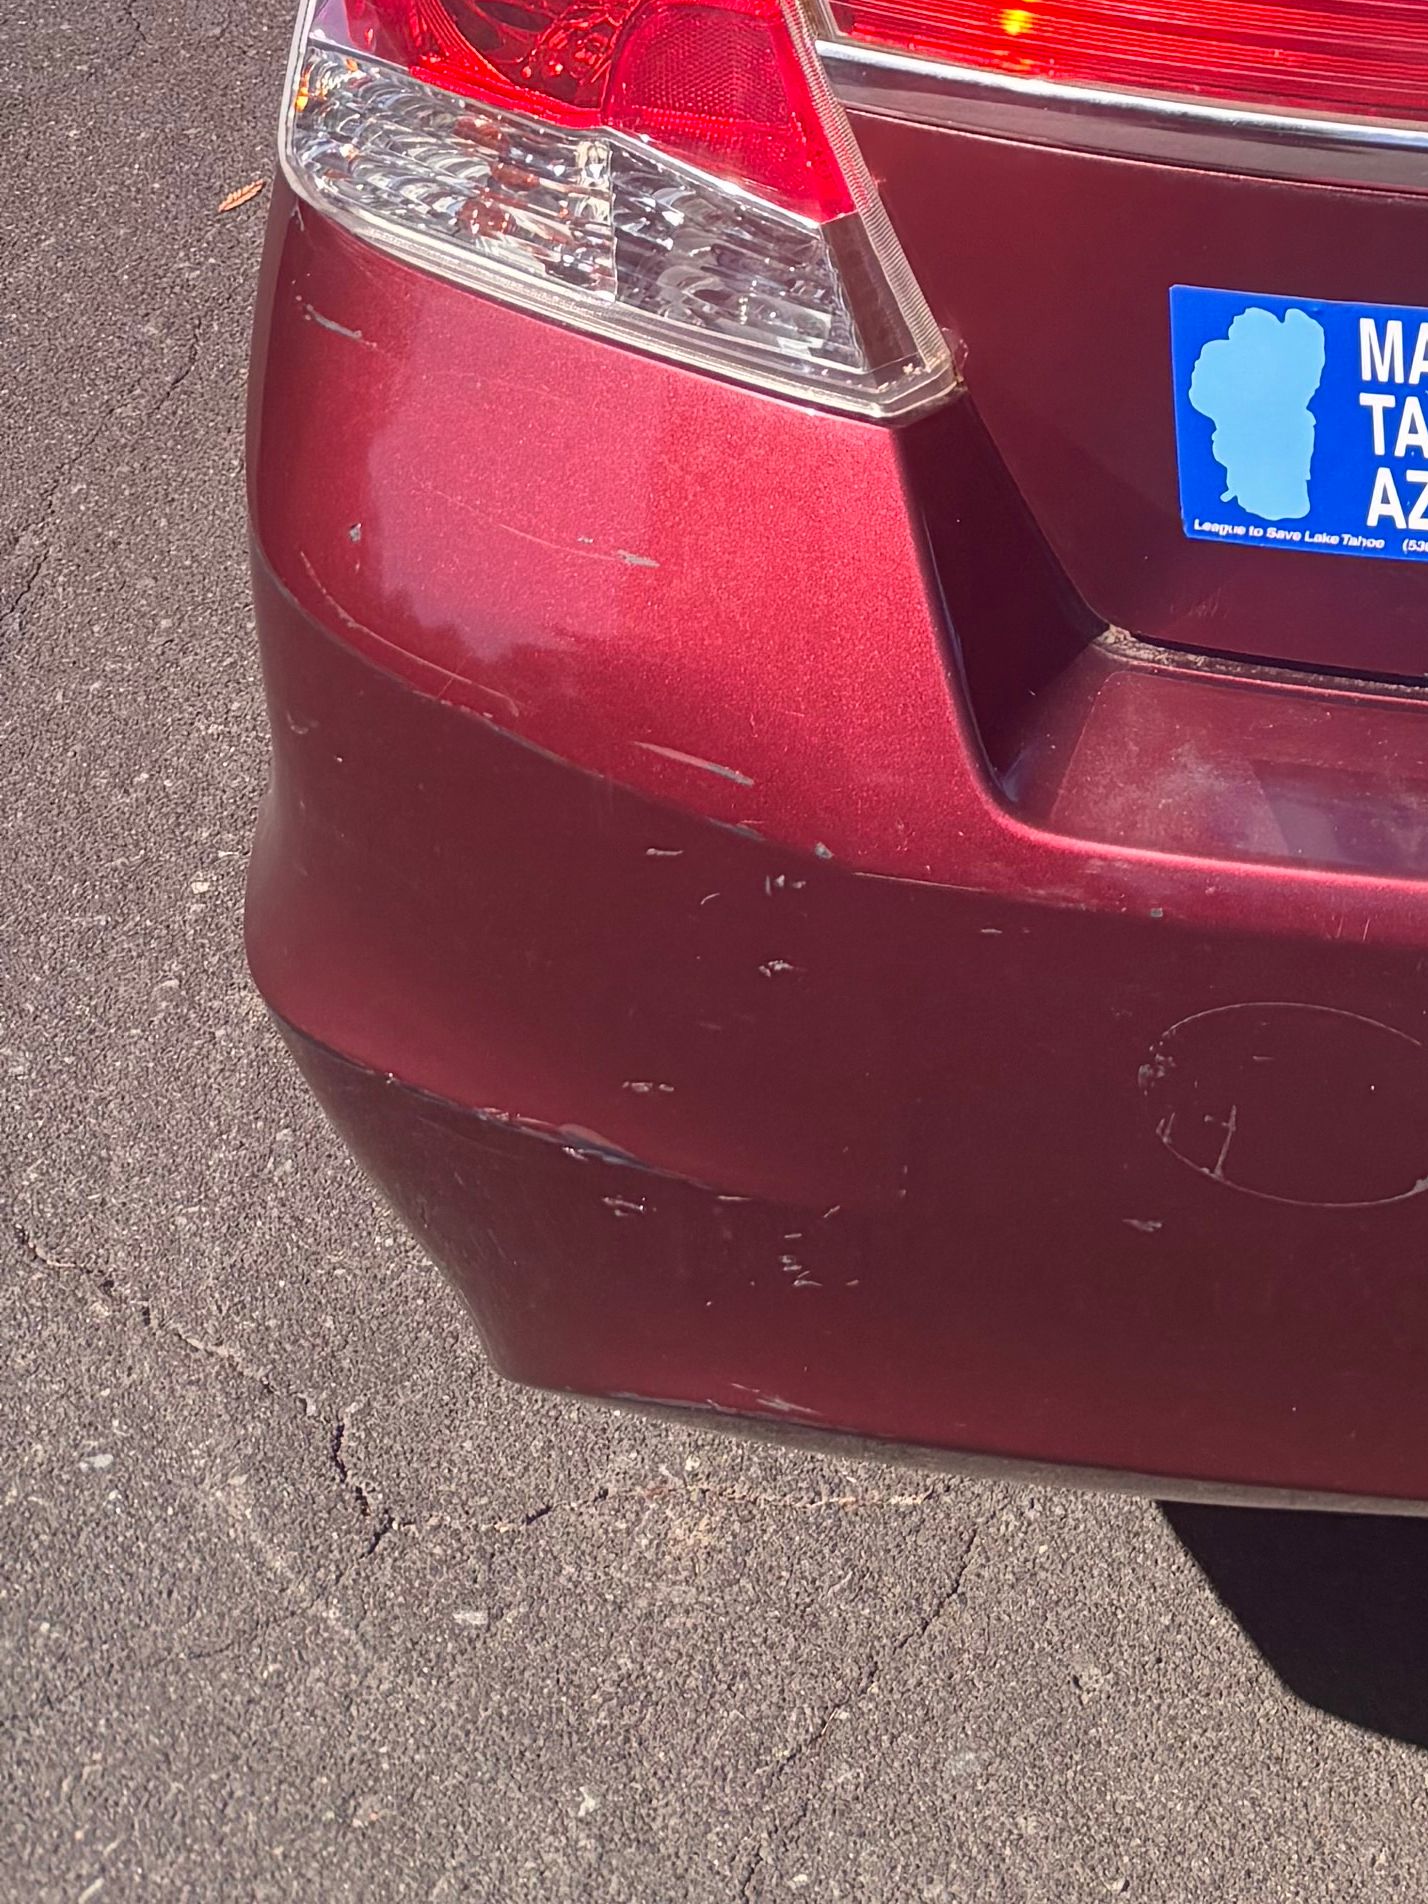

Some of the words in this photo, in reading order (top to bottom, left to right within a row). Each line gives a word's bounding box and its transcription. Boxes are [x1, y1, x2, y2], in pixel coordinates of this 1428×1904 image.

[1193, 518, 1247, 537] League
[1248, 524, 1264, 538] to
[1265, 527, 1302, 542] Save
[1304, 530, 1340, 546] Lake
[1341, 533, 1386, 550] Tahoe
